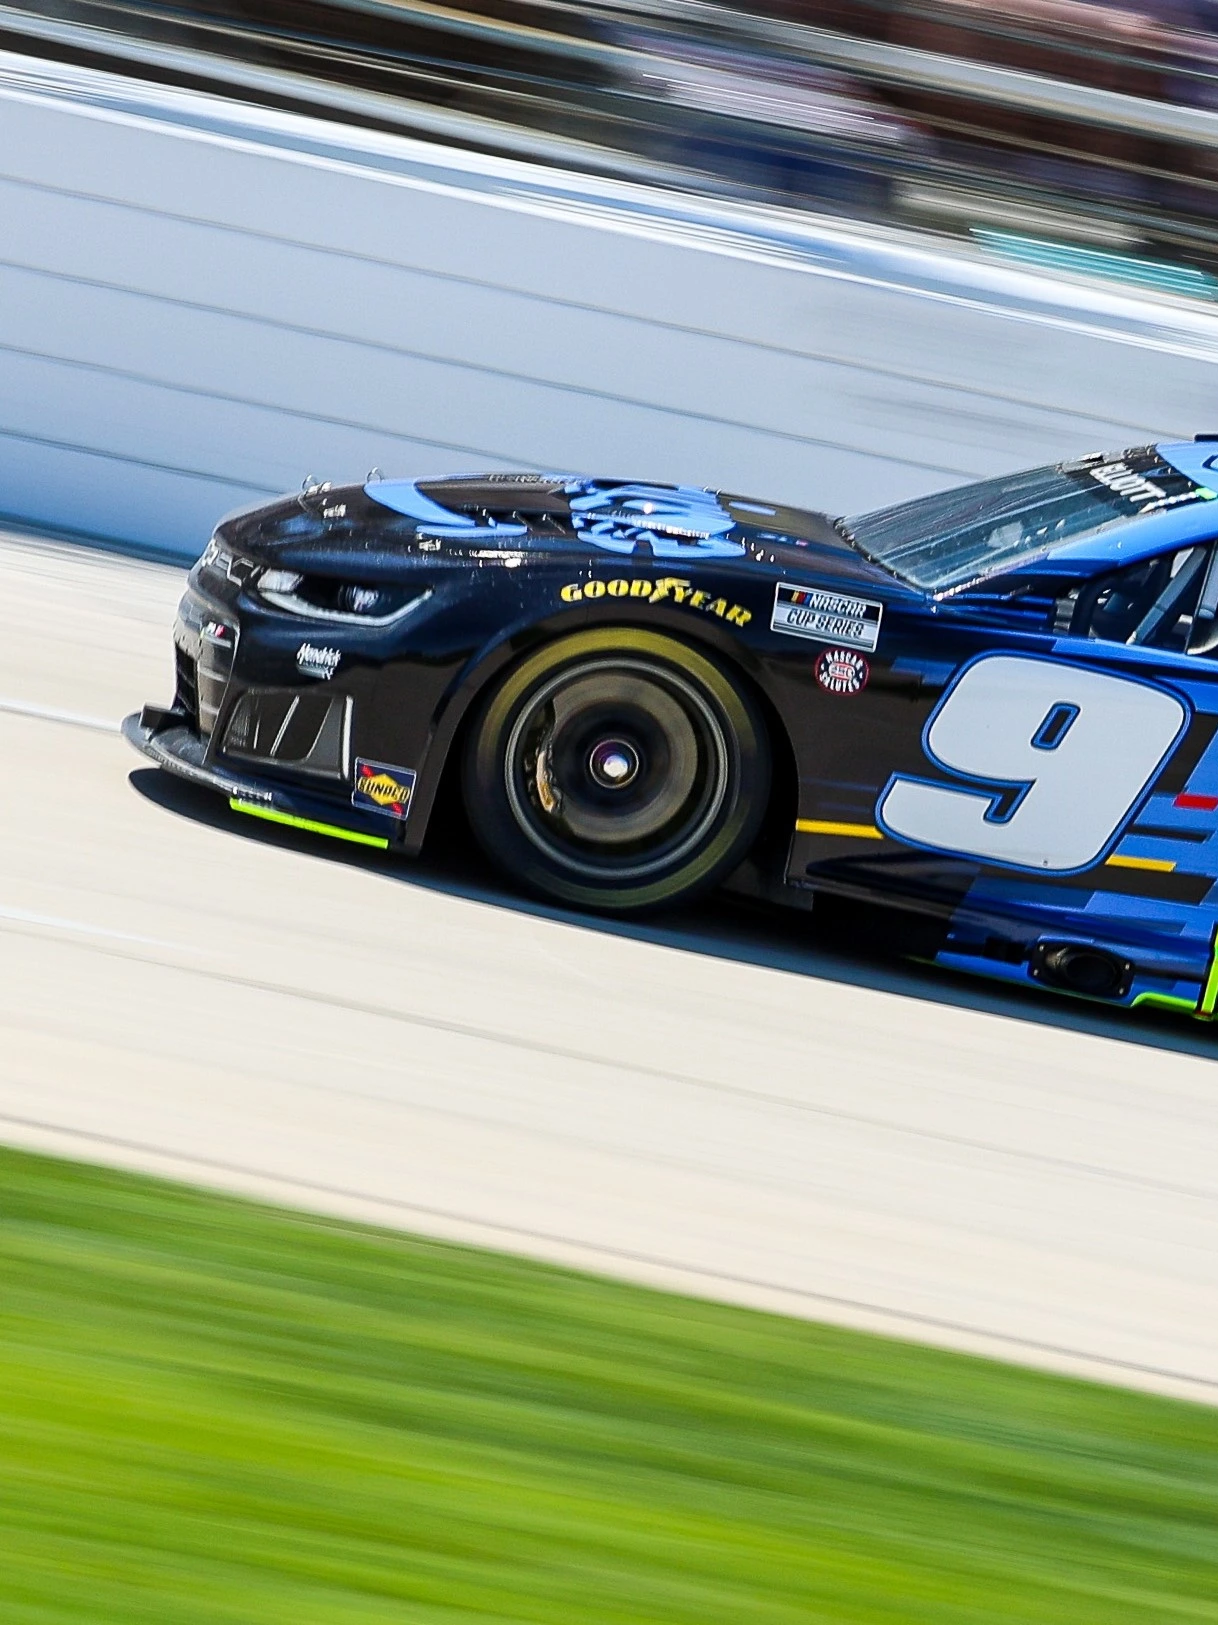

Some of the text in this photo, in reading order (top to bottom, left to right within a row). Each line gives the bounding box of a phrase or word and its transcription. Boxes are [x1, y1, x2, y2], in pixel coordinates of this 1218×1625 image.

[560, 576, 752, 628] GOODYEAR
[809, 592, 867, 619] NASCAR
[786, 608, 864, 637] CUP SERIES
[880, 654, 1187, 873] 9
